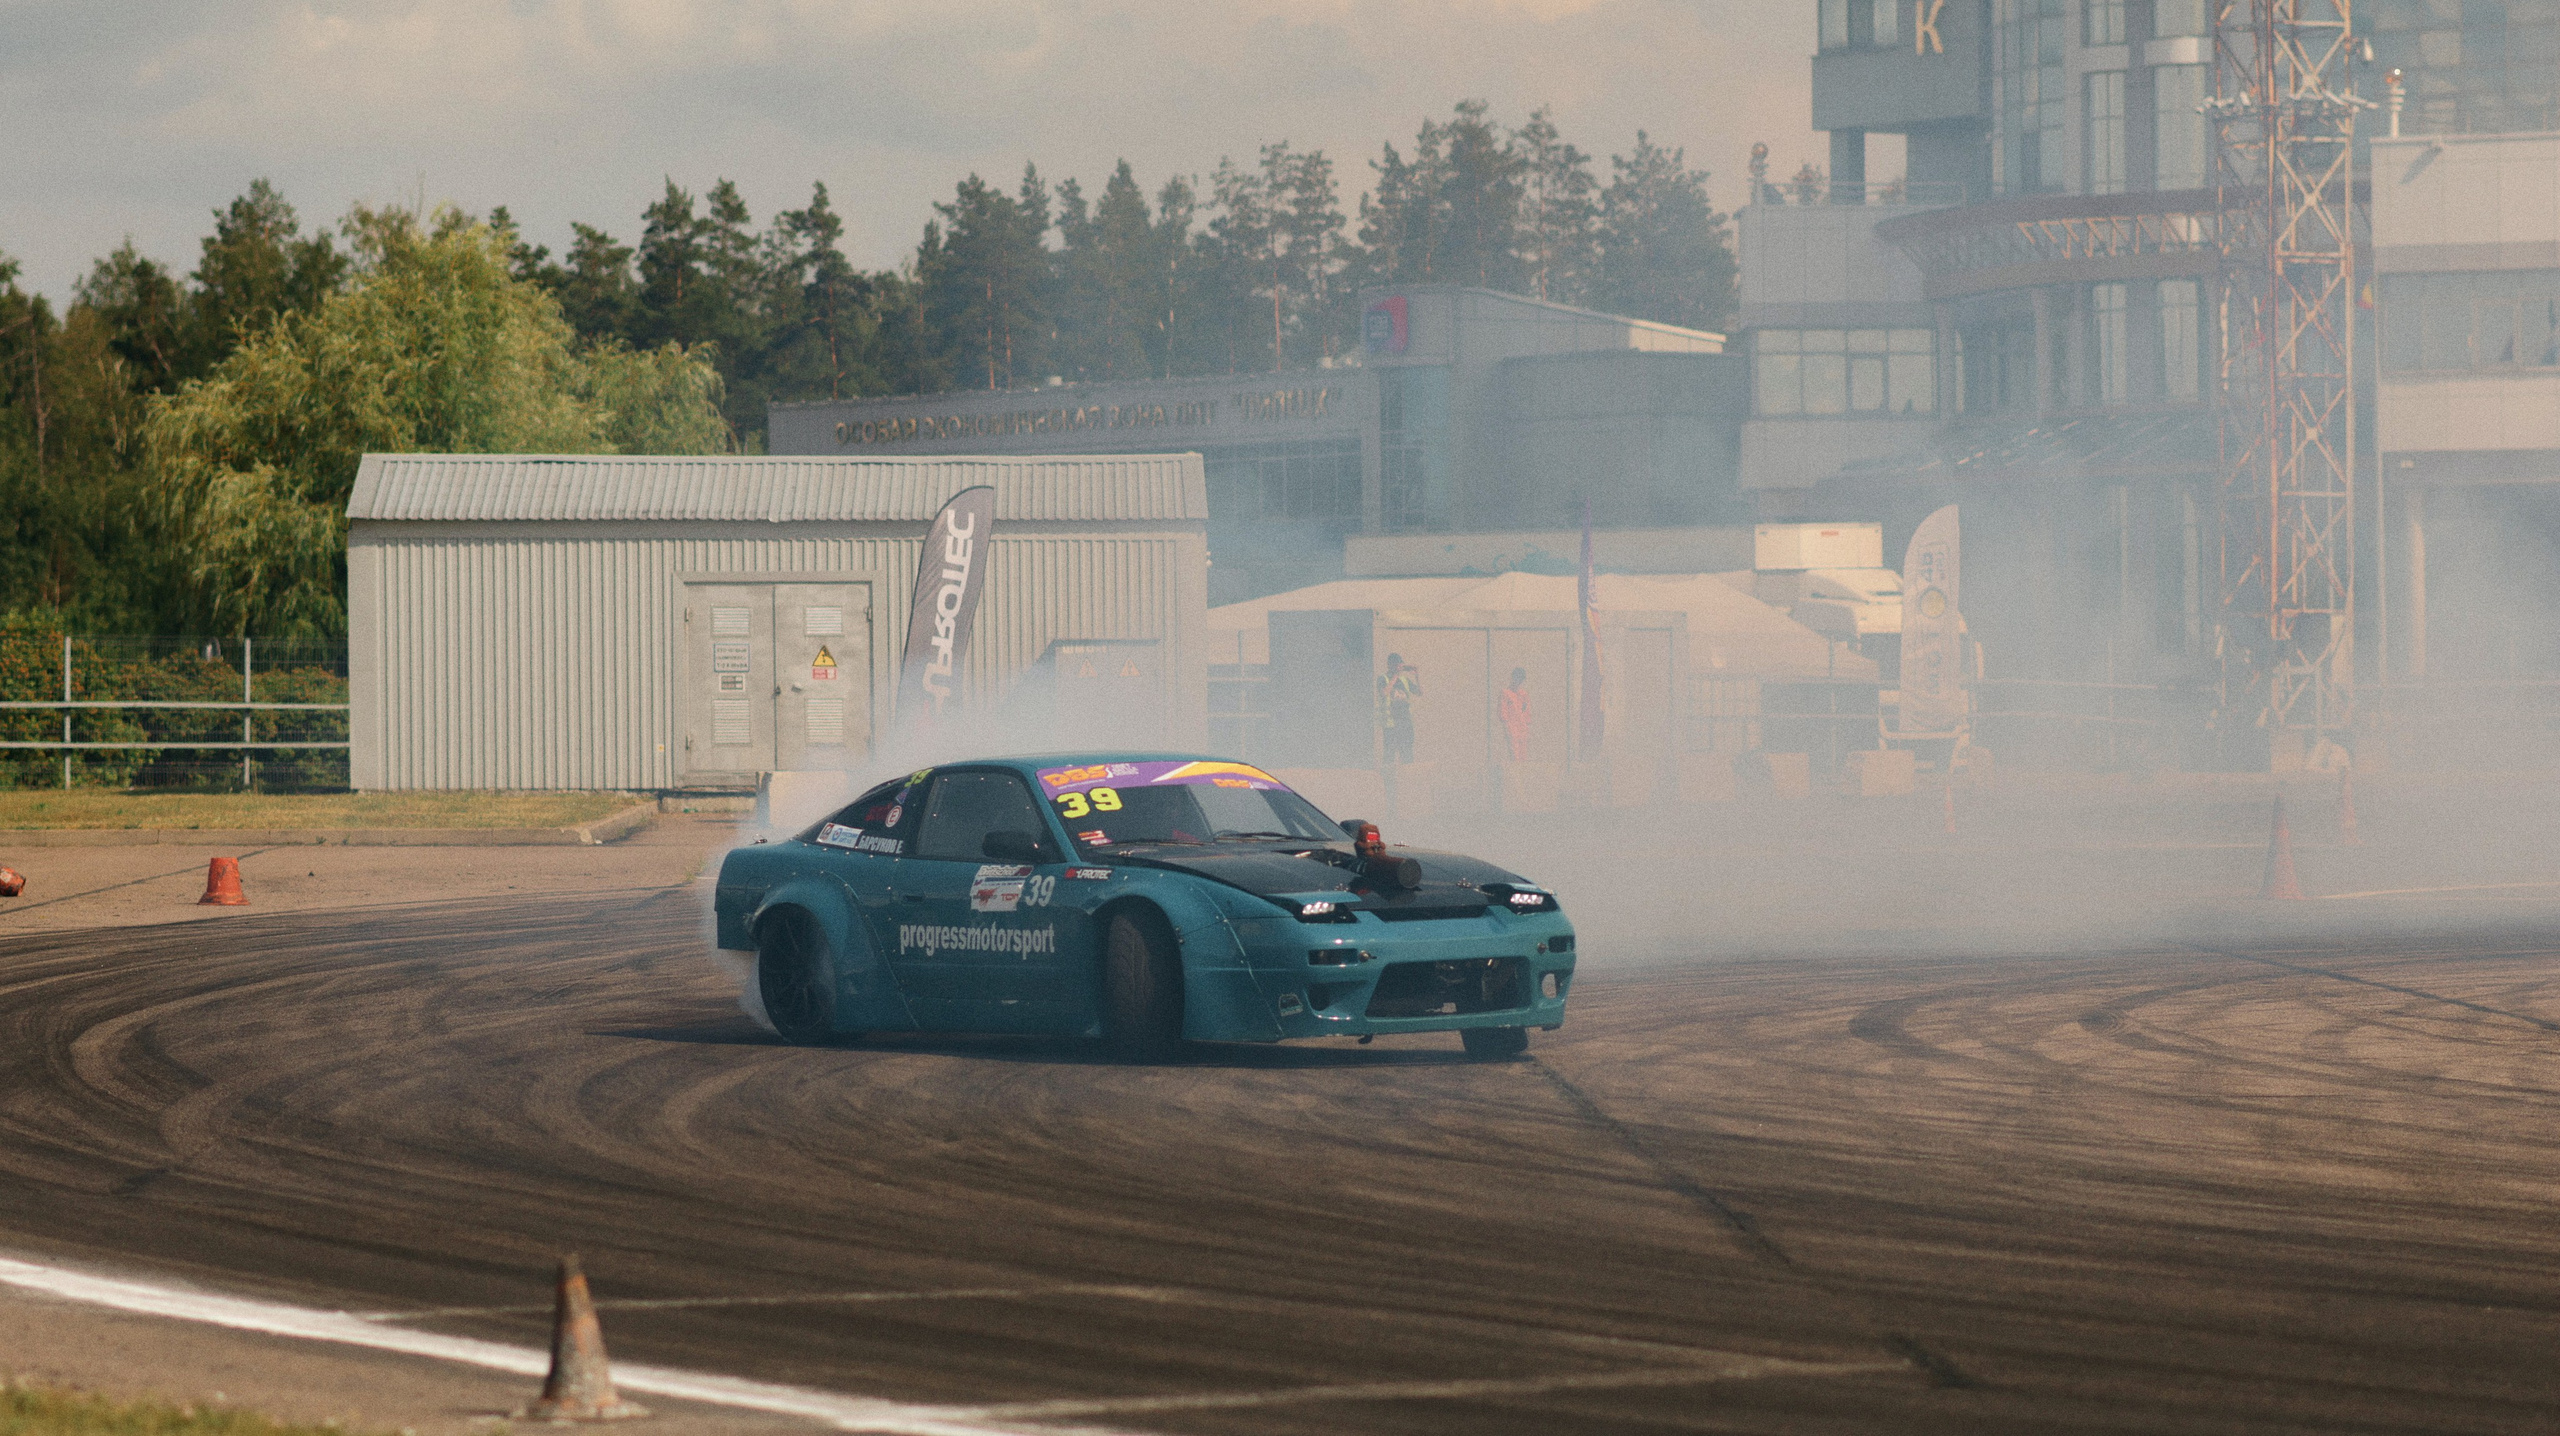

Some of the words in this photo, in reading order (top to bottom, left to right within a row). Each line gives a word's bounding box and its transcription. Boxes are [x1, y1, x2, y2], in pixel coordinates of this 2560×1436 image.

[835, 417, 917, 445] ОСОБАЯ
[922, 405, 1102, 440] ЭКОНОМИЧЕСКАЯ
[1108, 403, 1168, 428] ЗОНА
[1056, 787, 1124, 819] 39
[858, 835, 897, 853] БАРСУКОВ
[1025, 874, 1056, 907] 39
[899, 921, 1056, 960] progressmotorsport
